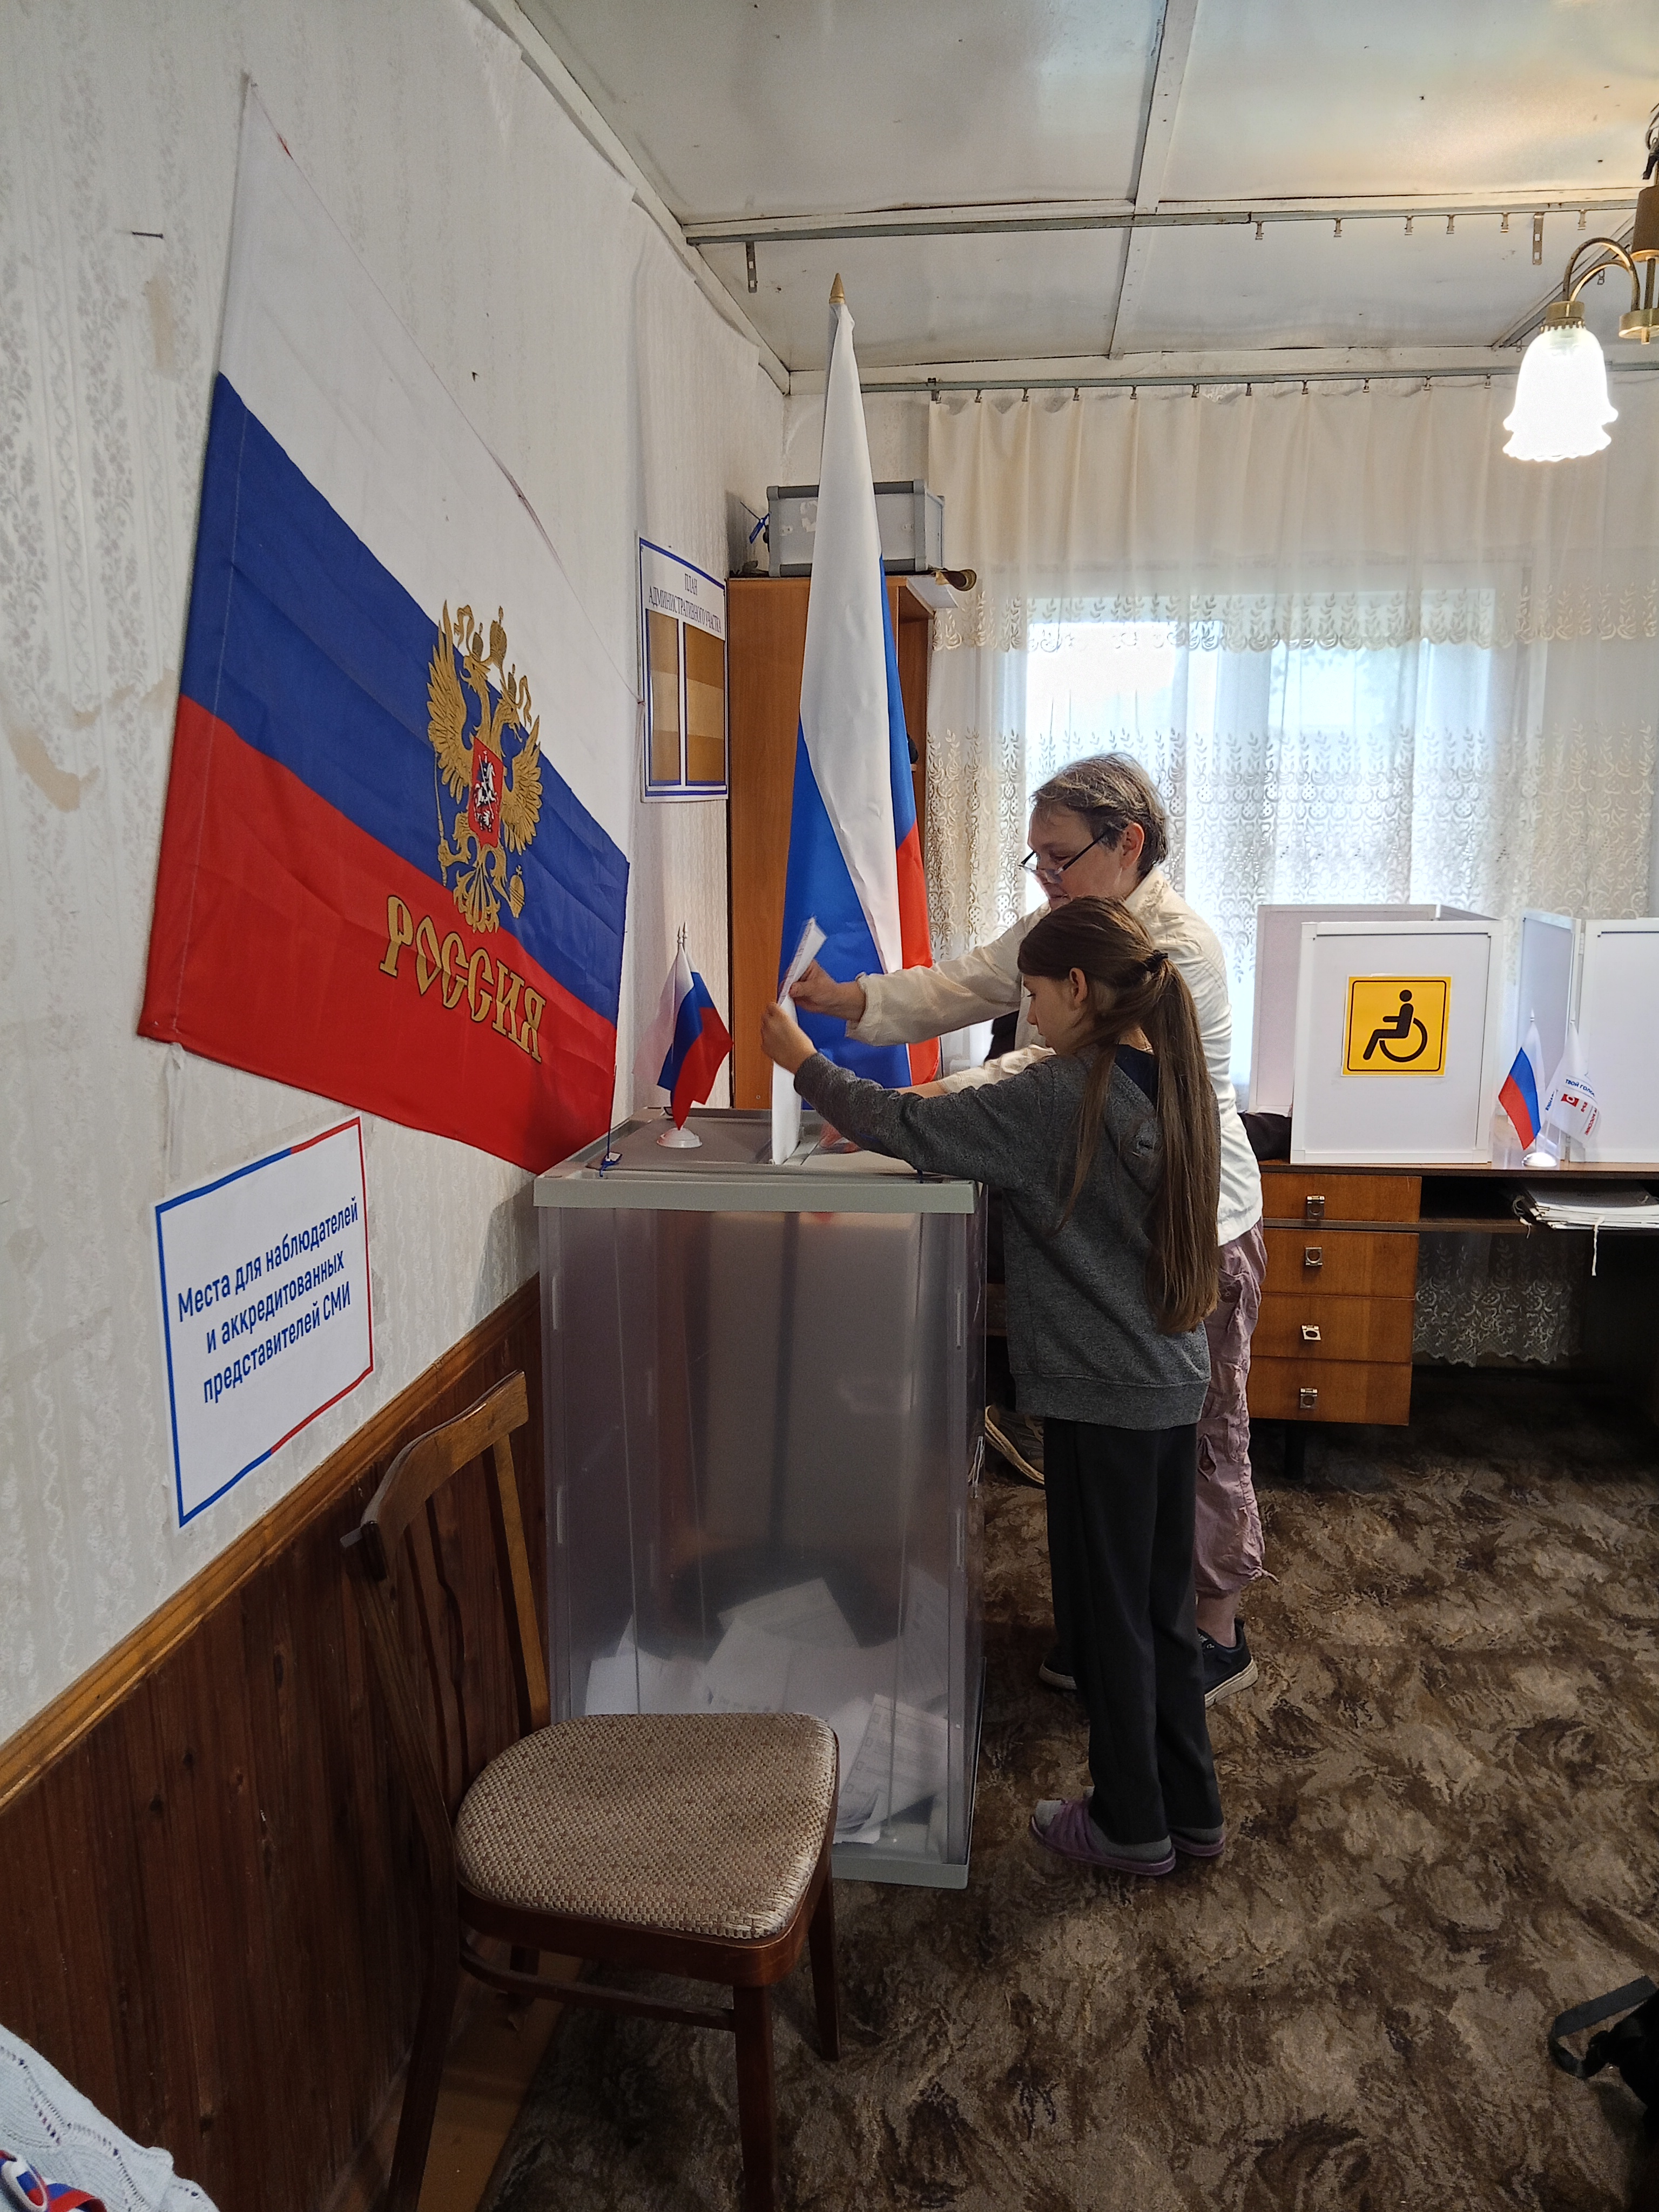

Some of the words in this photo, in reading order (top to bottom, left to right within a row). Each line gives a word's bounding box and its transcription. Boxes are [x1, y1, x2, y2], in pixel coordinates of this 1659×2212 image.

[685, 573, 698, 596] ПЛАН
[379, 895, 547, 1063] РОССИЯ
[1565, 1078, 1580, 1087] ТВОЙ
[177, 1278, 231, 1322] Места
[235, 1256, 261, 1295] для
[266, 1196, 359, 1272] наблюдателей
[206, 1328, 217, 1354] и
[221, 1250, 346, 1346] аккредитованных
[203, 1301, 321, 1404] представителей
[323, 1281, 351, 1320] СМИ
